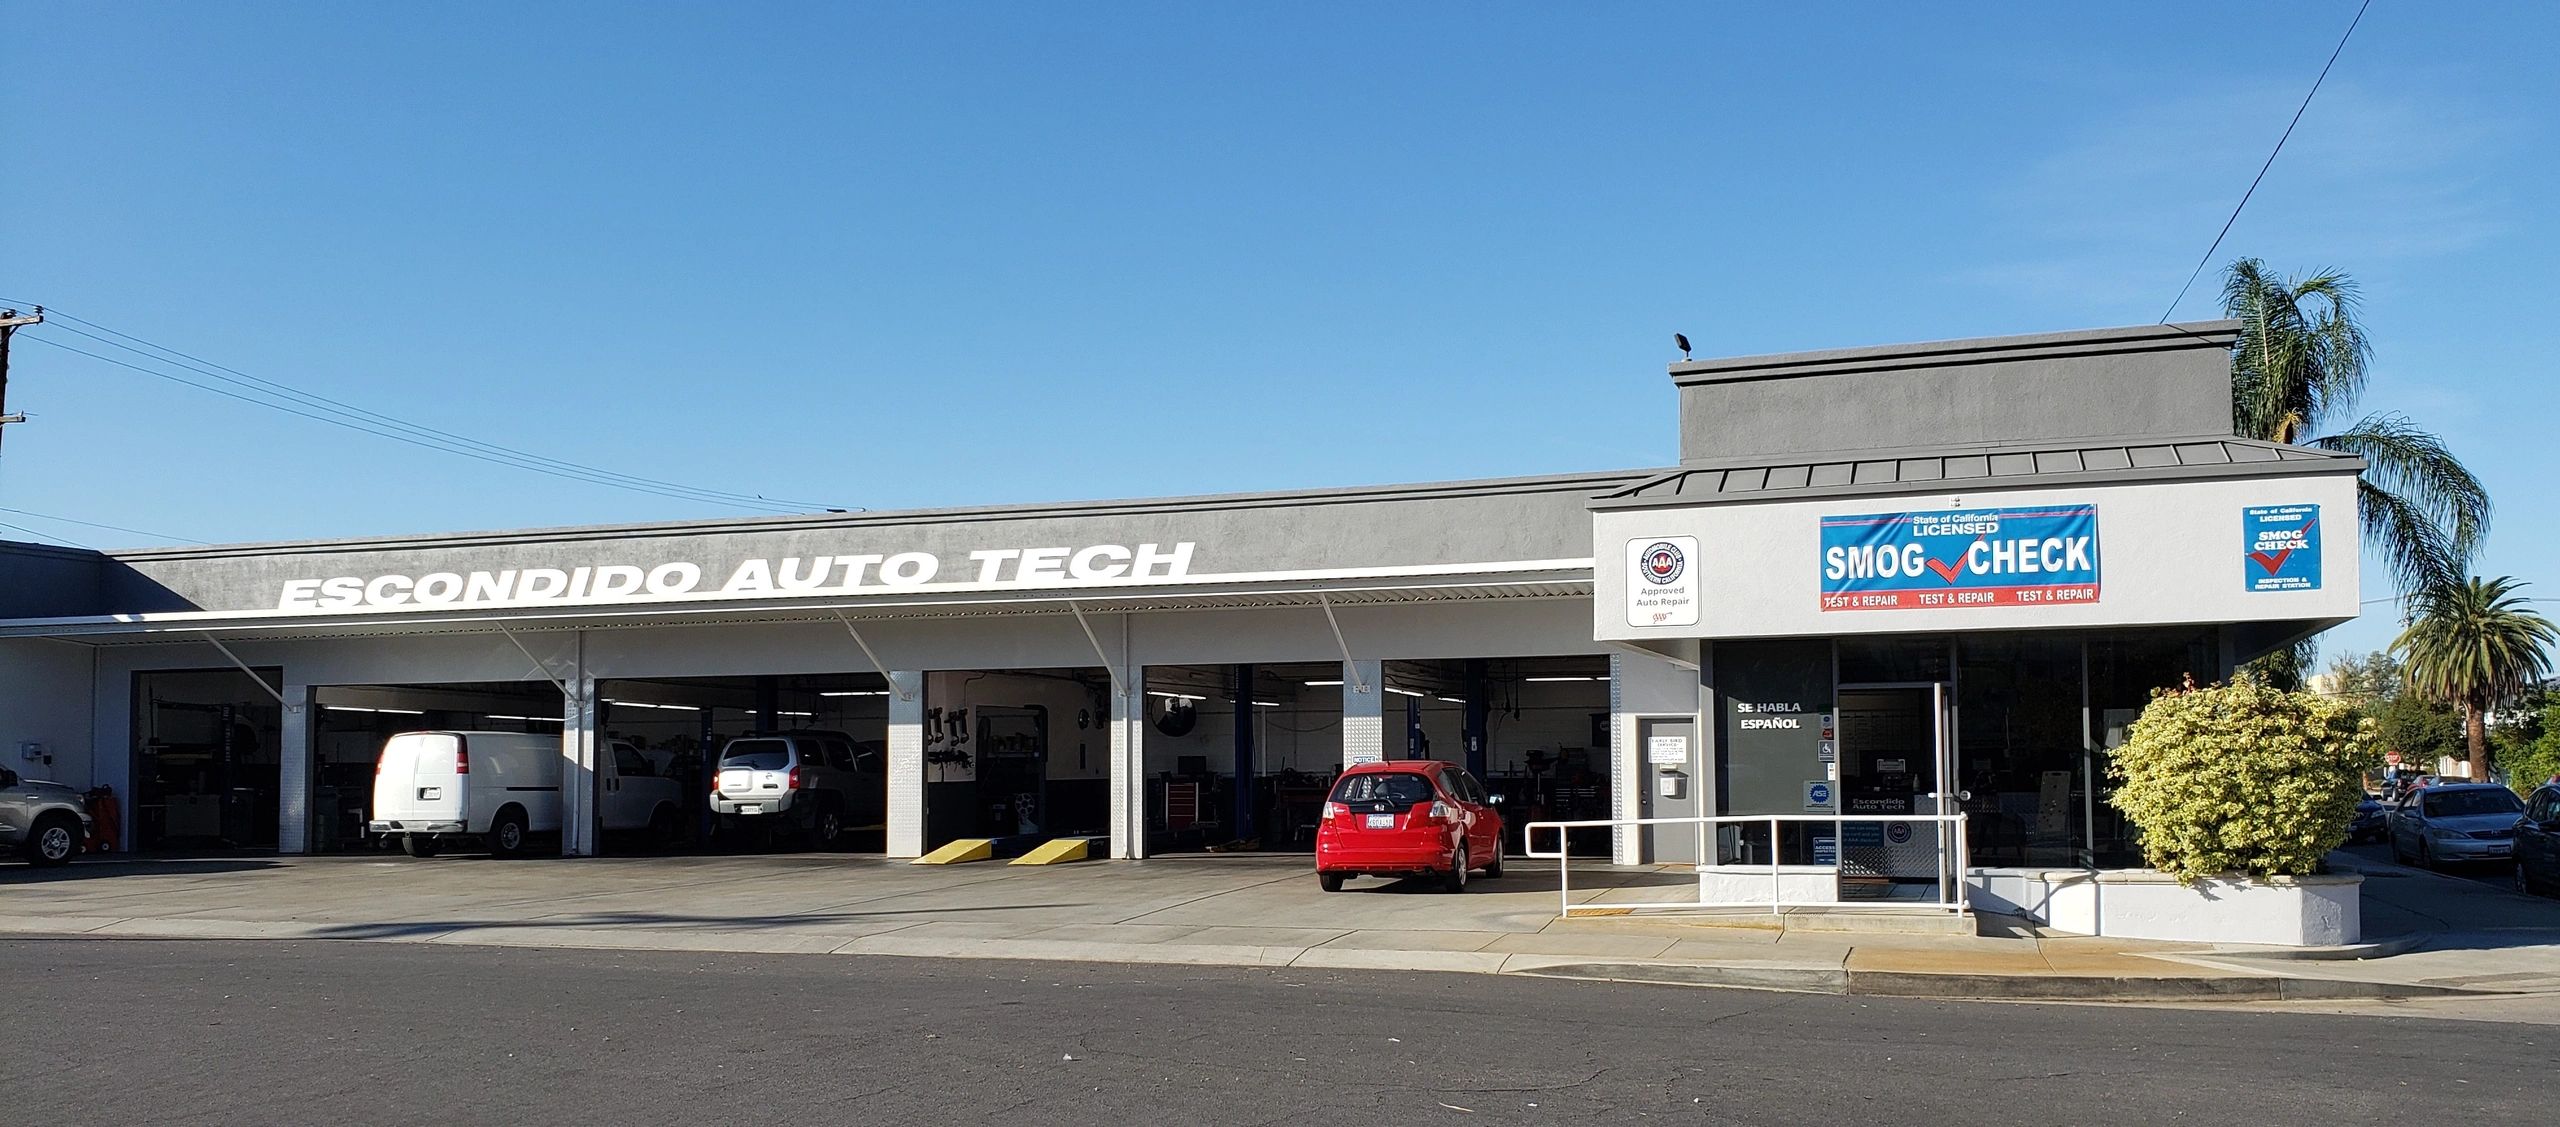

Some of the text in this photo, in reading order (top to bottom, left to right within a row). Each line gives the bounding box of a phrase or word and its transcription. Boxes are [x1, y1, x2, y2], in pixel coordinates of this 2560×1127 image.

[1913, 513, 1999, 524] State of California
[2259, 514, 2302, 522] LICENSED
[1913, 523, 1999, 537] LICENSED
[2258, 530, 2303, 540] SMOG
[2254, 540, 2309, 551] CHECK
[1652, 555, 1673, 568] AAA
[1825, 535, 2091, 580] SMOG CHECK
[278, 541, 1196, 611] ESCONDIDO AUTO TECH
[1641, 586, 1685, 596] Approved
[2016, 588, 2094, 602] TEST & REPAIR
[1660, 597, 1690, 607] Repair
[1824, 595, 1898, 608] TEST & REPAIR
[1919, 592, 1994, 605] TEST & REPAIR
[1737, 702, 1802, 713] SE HABLA
[1740, 717, 1800, 729] ESPAÑOL
